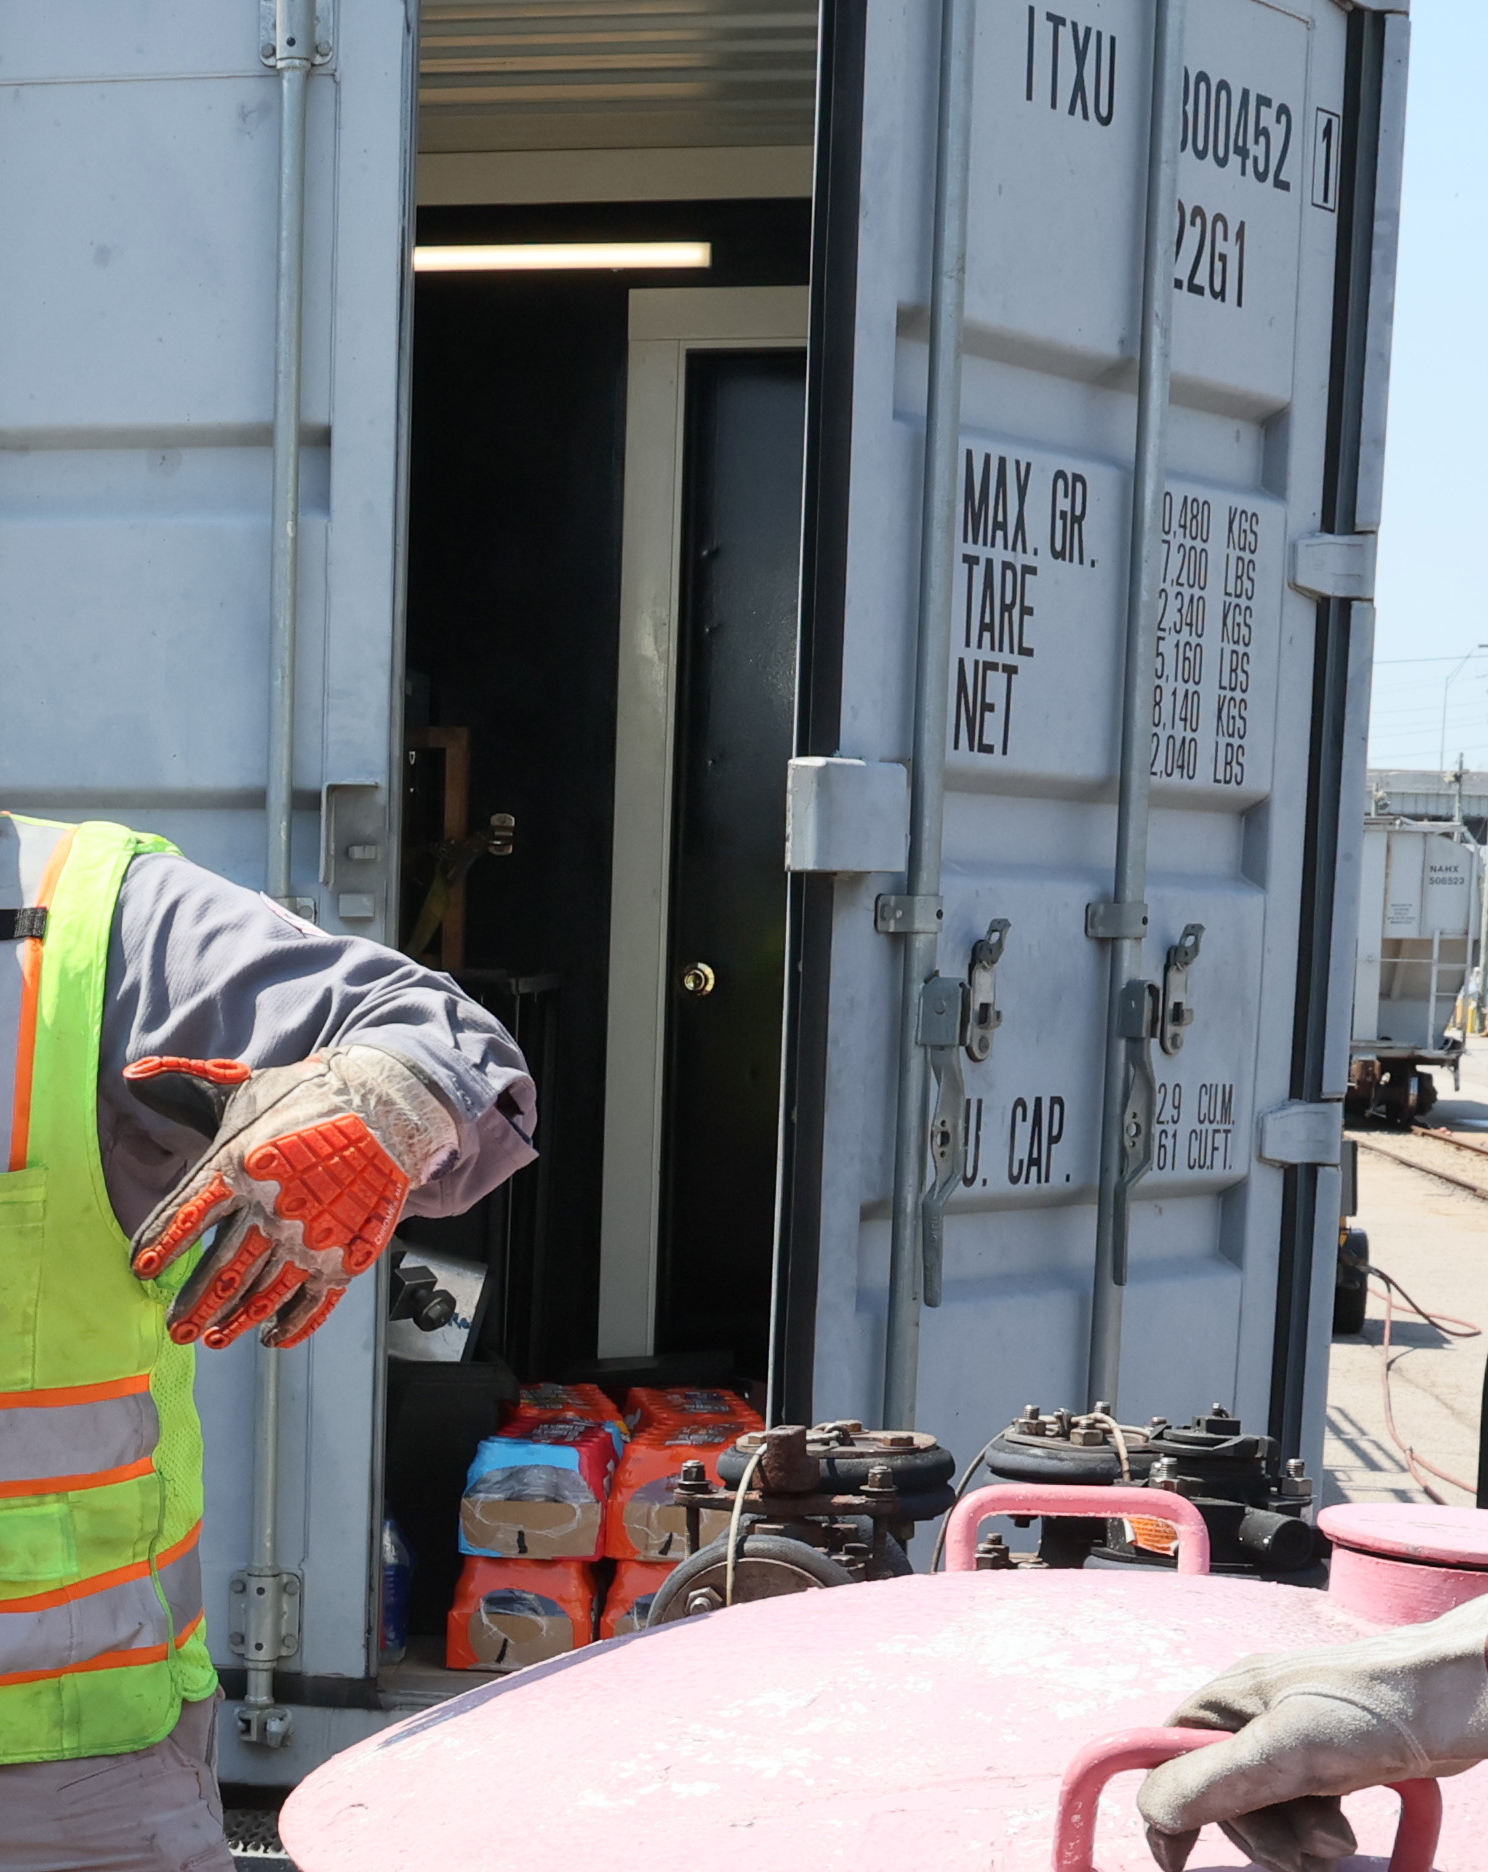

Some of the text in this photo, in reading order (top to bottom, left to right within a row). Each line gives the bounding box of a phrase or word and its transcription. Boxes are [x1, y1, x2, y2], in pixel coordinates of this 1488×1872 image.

[1026, 4, 1117, 127] ITXU
[963, 448, 1097, 567] MAX. GR.
[1227, 505, 1259, 554] KGS
[1224, 553, 1255, 601] LBS
[962, 553, 1037, 657] TARE
[1221, 600, 1252, 647] KGS
[1219, 647, 1250, 693] LBS
[953, 657, 1018, 755] NET
[1216, 694, 1247, 740] KGS
[1213, 741, 1245, 786] LBS
[1430, 865, 1459, 873] NAHX
[1198, 1083, 1234, 1125] CU.M.
[1008, 1096, 1070, 1185] CAP.
[1150, 1129, 1232, 1171] 61 CU.FT.
